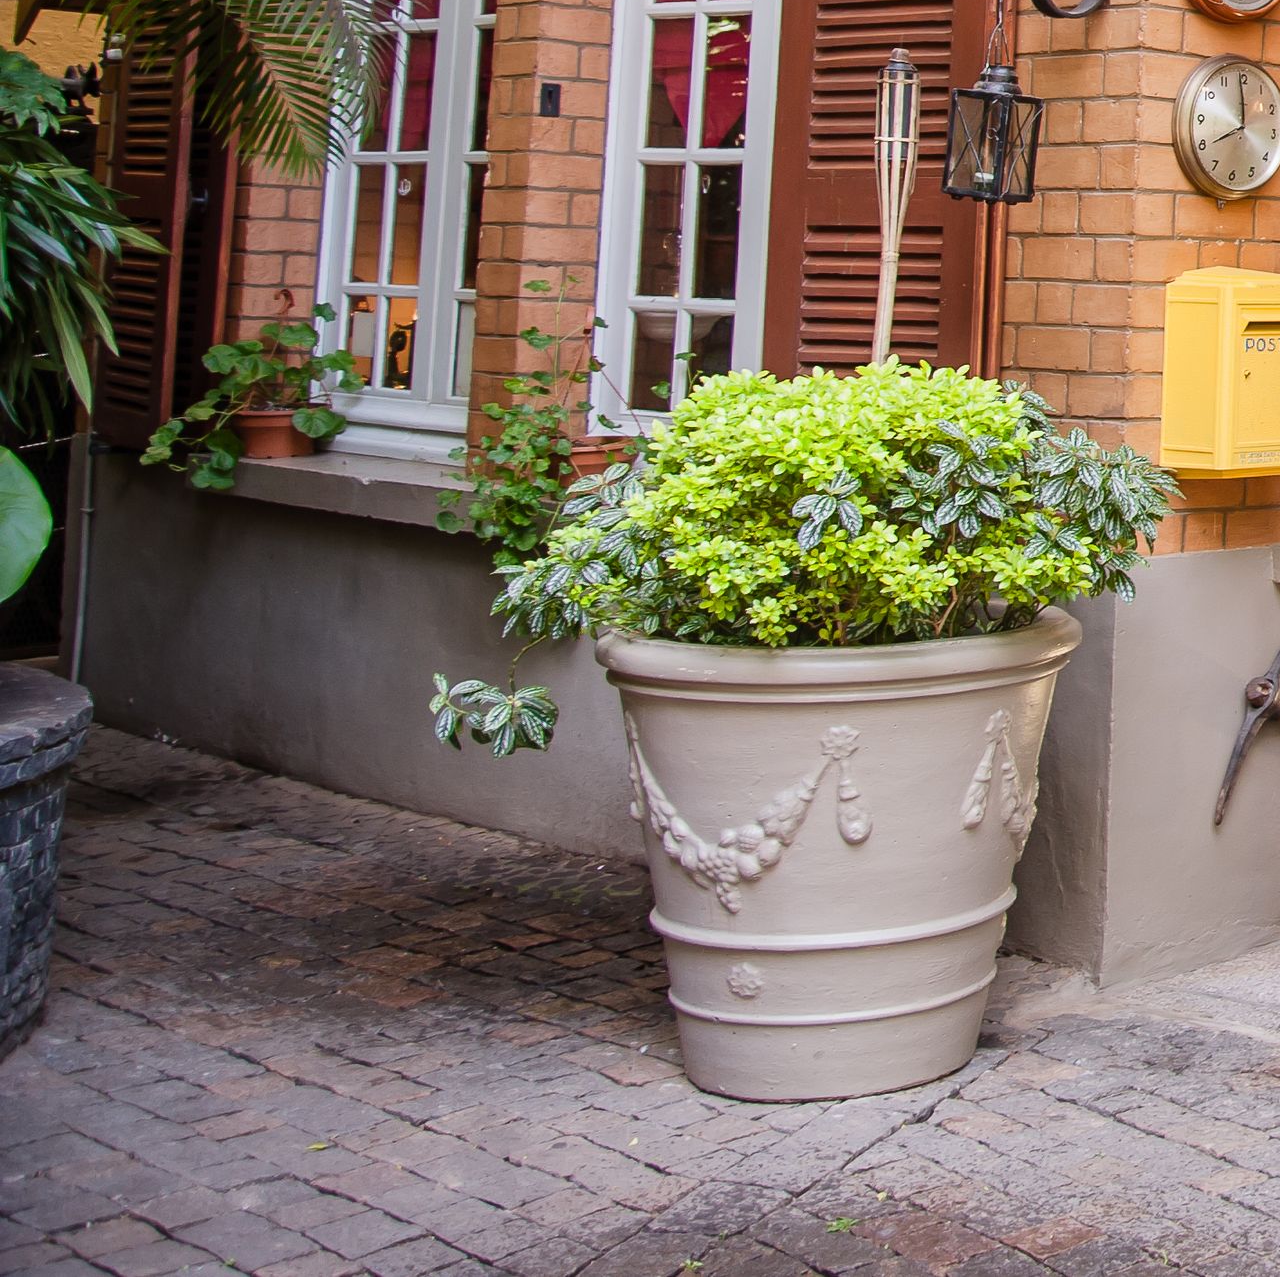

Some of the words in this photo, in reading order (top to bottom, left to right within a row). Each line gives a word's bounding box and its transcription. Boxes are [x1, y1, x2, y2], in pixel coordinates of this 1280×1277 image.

[1221, 76, 1228, 87] 11
[1239, 74, 1248, 85] 2
[1204, 91, 1215, 101] 10
[1269, 104, 1275, 115] 2
[1197, 114, 1205, 124] 9
[1271, 129, 1276, 139] 3
[1198, 139, 1206, 150] 8
[1262, 151, 1268, 162] 4
[1211, 160, 1219, 171] 7
[1228, 170, 1235, 181] 6
[1248, 167, 1255, 177] 5
